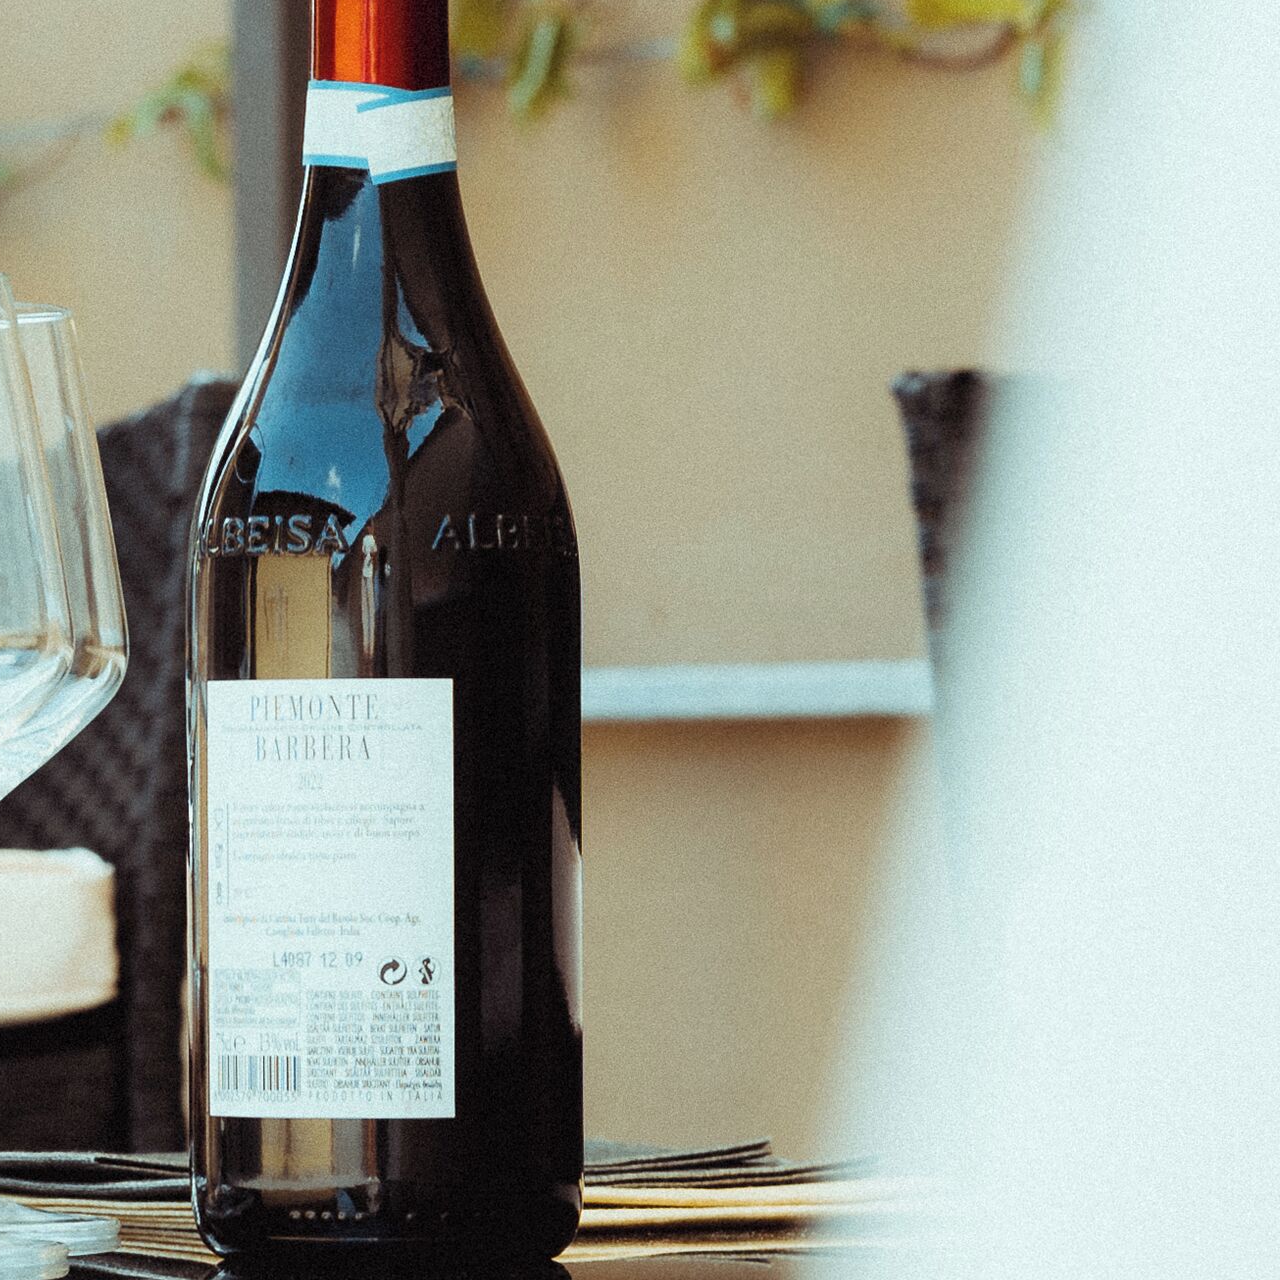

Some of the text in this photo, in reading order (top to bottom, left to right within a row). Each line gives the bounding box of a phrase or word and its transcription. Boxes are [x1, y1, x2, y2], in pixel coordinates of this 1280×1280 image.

[204, 513, 350, 557] LBEISA
[250, 694, 379, 722] PIEMONTE
[256, 735, 371, 762] BARBERA
[272, 950, 364, 969] L4087 12 09
[381, 1091, 393, 1101] IN
